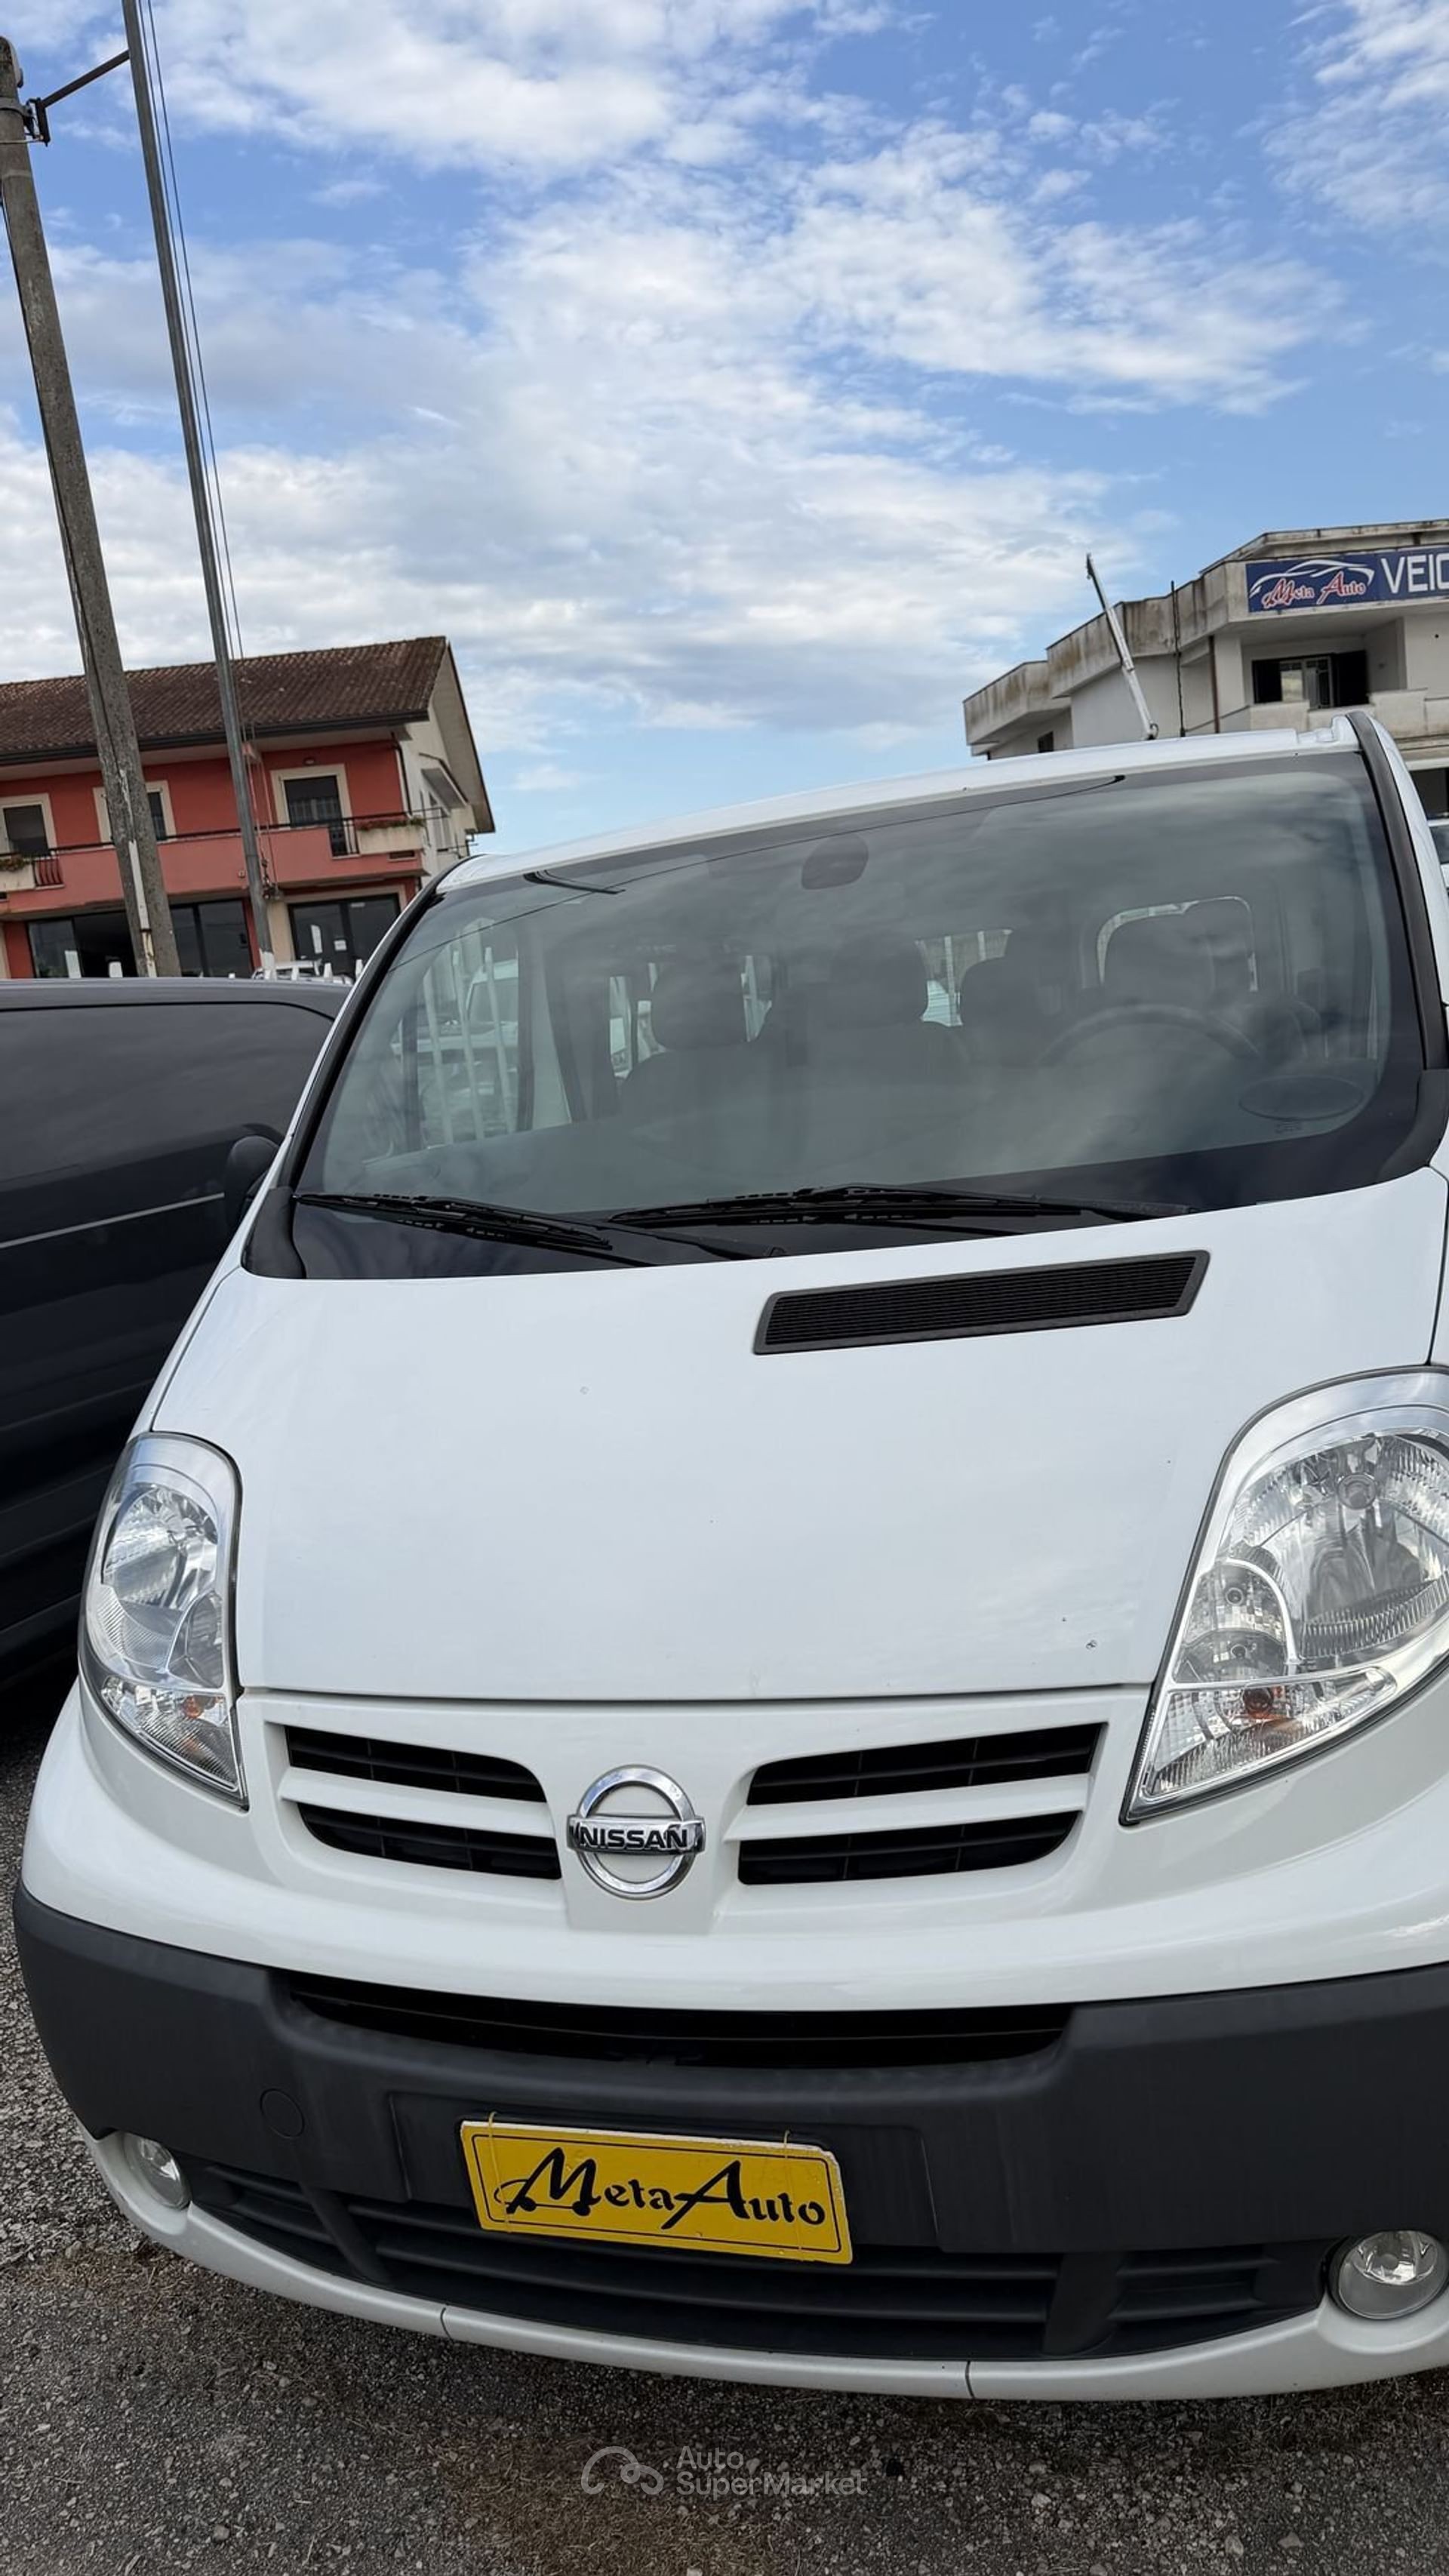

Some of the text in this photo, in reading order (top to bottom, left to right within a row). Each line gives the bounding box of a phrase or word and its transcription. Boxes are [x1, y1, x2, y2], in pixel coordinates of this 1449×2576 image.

[1262, 571, 1366, 608] Meta Auto
[580, 1826, 688, 1849] NISSAN
